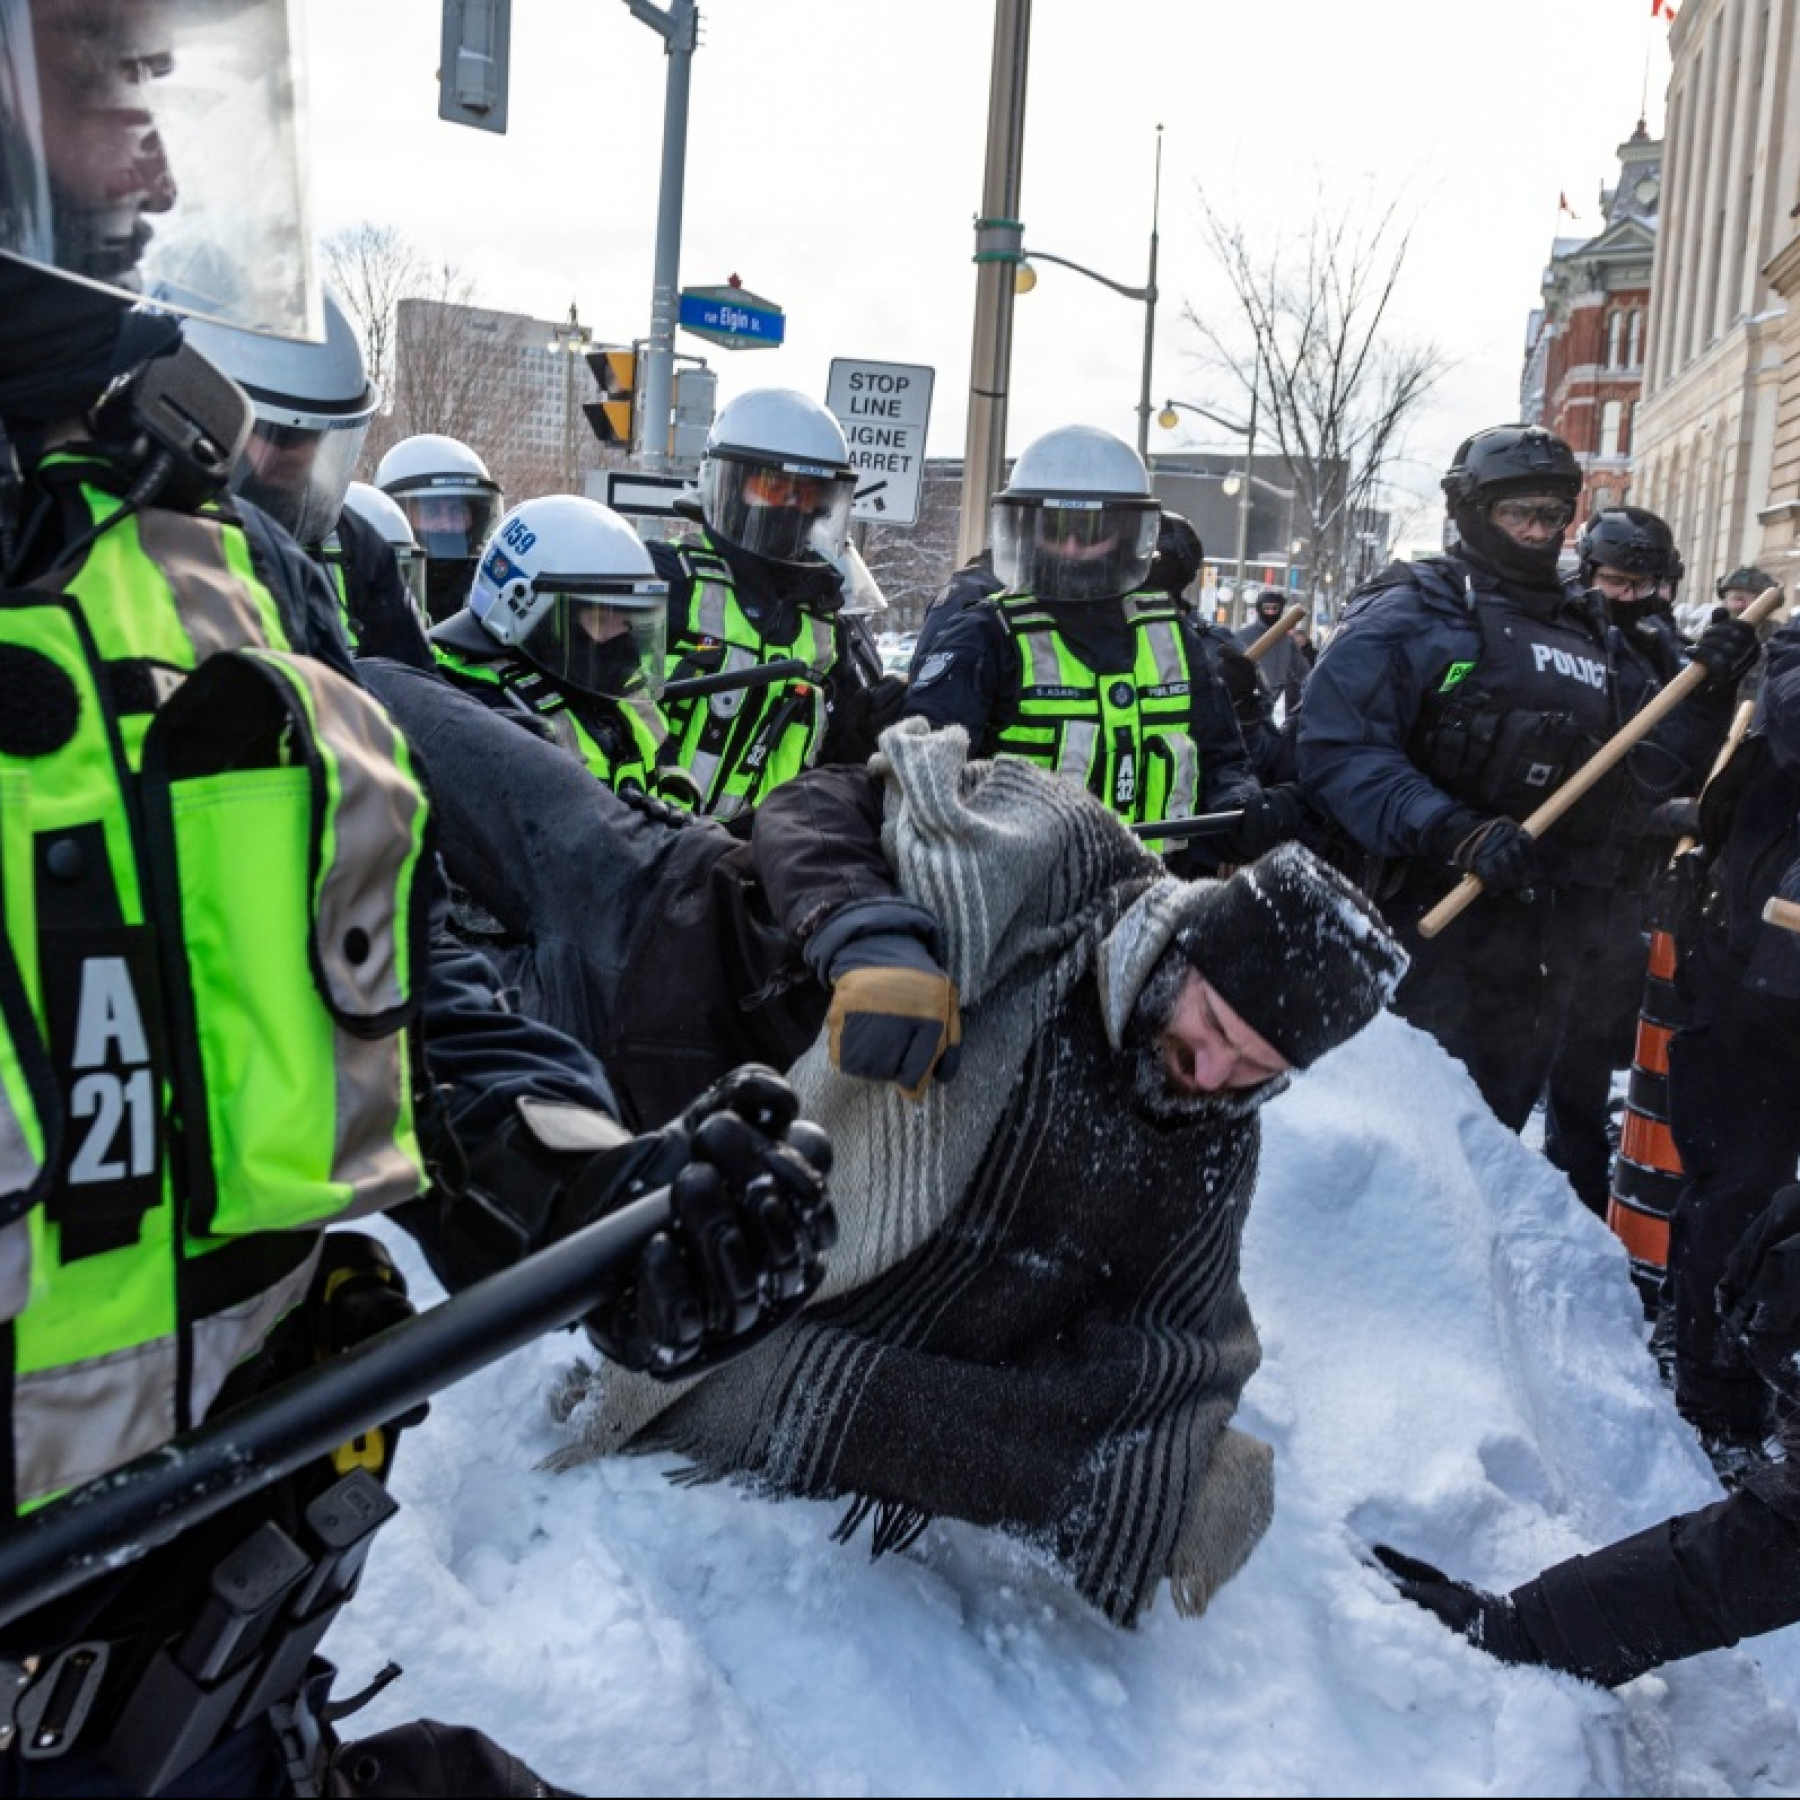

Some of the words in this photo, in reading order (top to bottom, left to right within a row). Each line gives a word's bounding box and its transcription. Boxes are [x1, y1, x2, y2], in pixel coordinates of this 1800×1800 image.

[720, 306, 748, 333] Elgin
[849, 372, 910, 394] STOP
[851, 395, 902, 418] LINE
[847, 426, 908, 448] IGNE
[1531, 643, 1607, 695] POLIC
[71, 956, 149, 1068] A
[68, 1068, 155, 1184] 21
